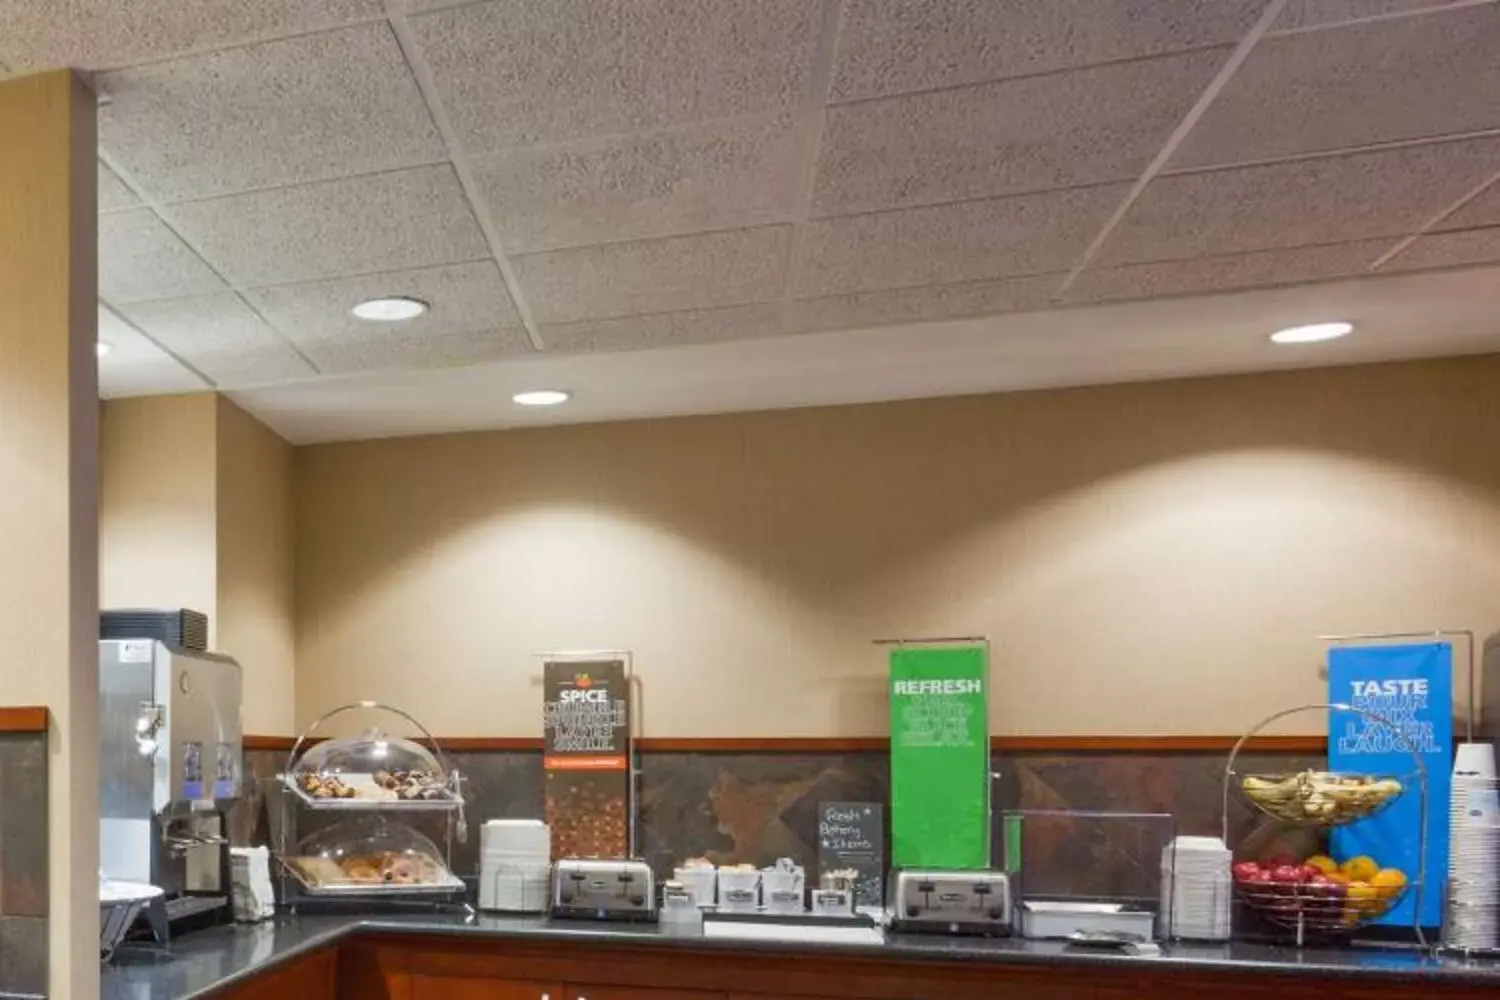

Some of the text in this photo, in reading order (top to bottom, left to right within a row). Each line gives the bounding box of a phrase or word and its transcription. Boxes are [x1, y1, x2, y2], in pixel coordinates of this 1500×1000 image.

[893, 678, 982, 695] REFRESH
[1349, 678, 1429, 696] TASTE
[560, 689, 607, 703] SPICE
